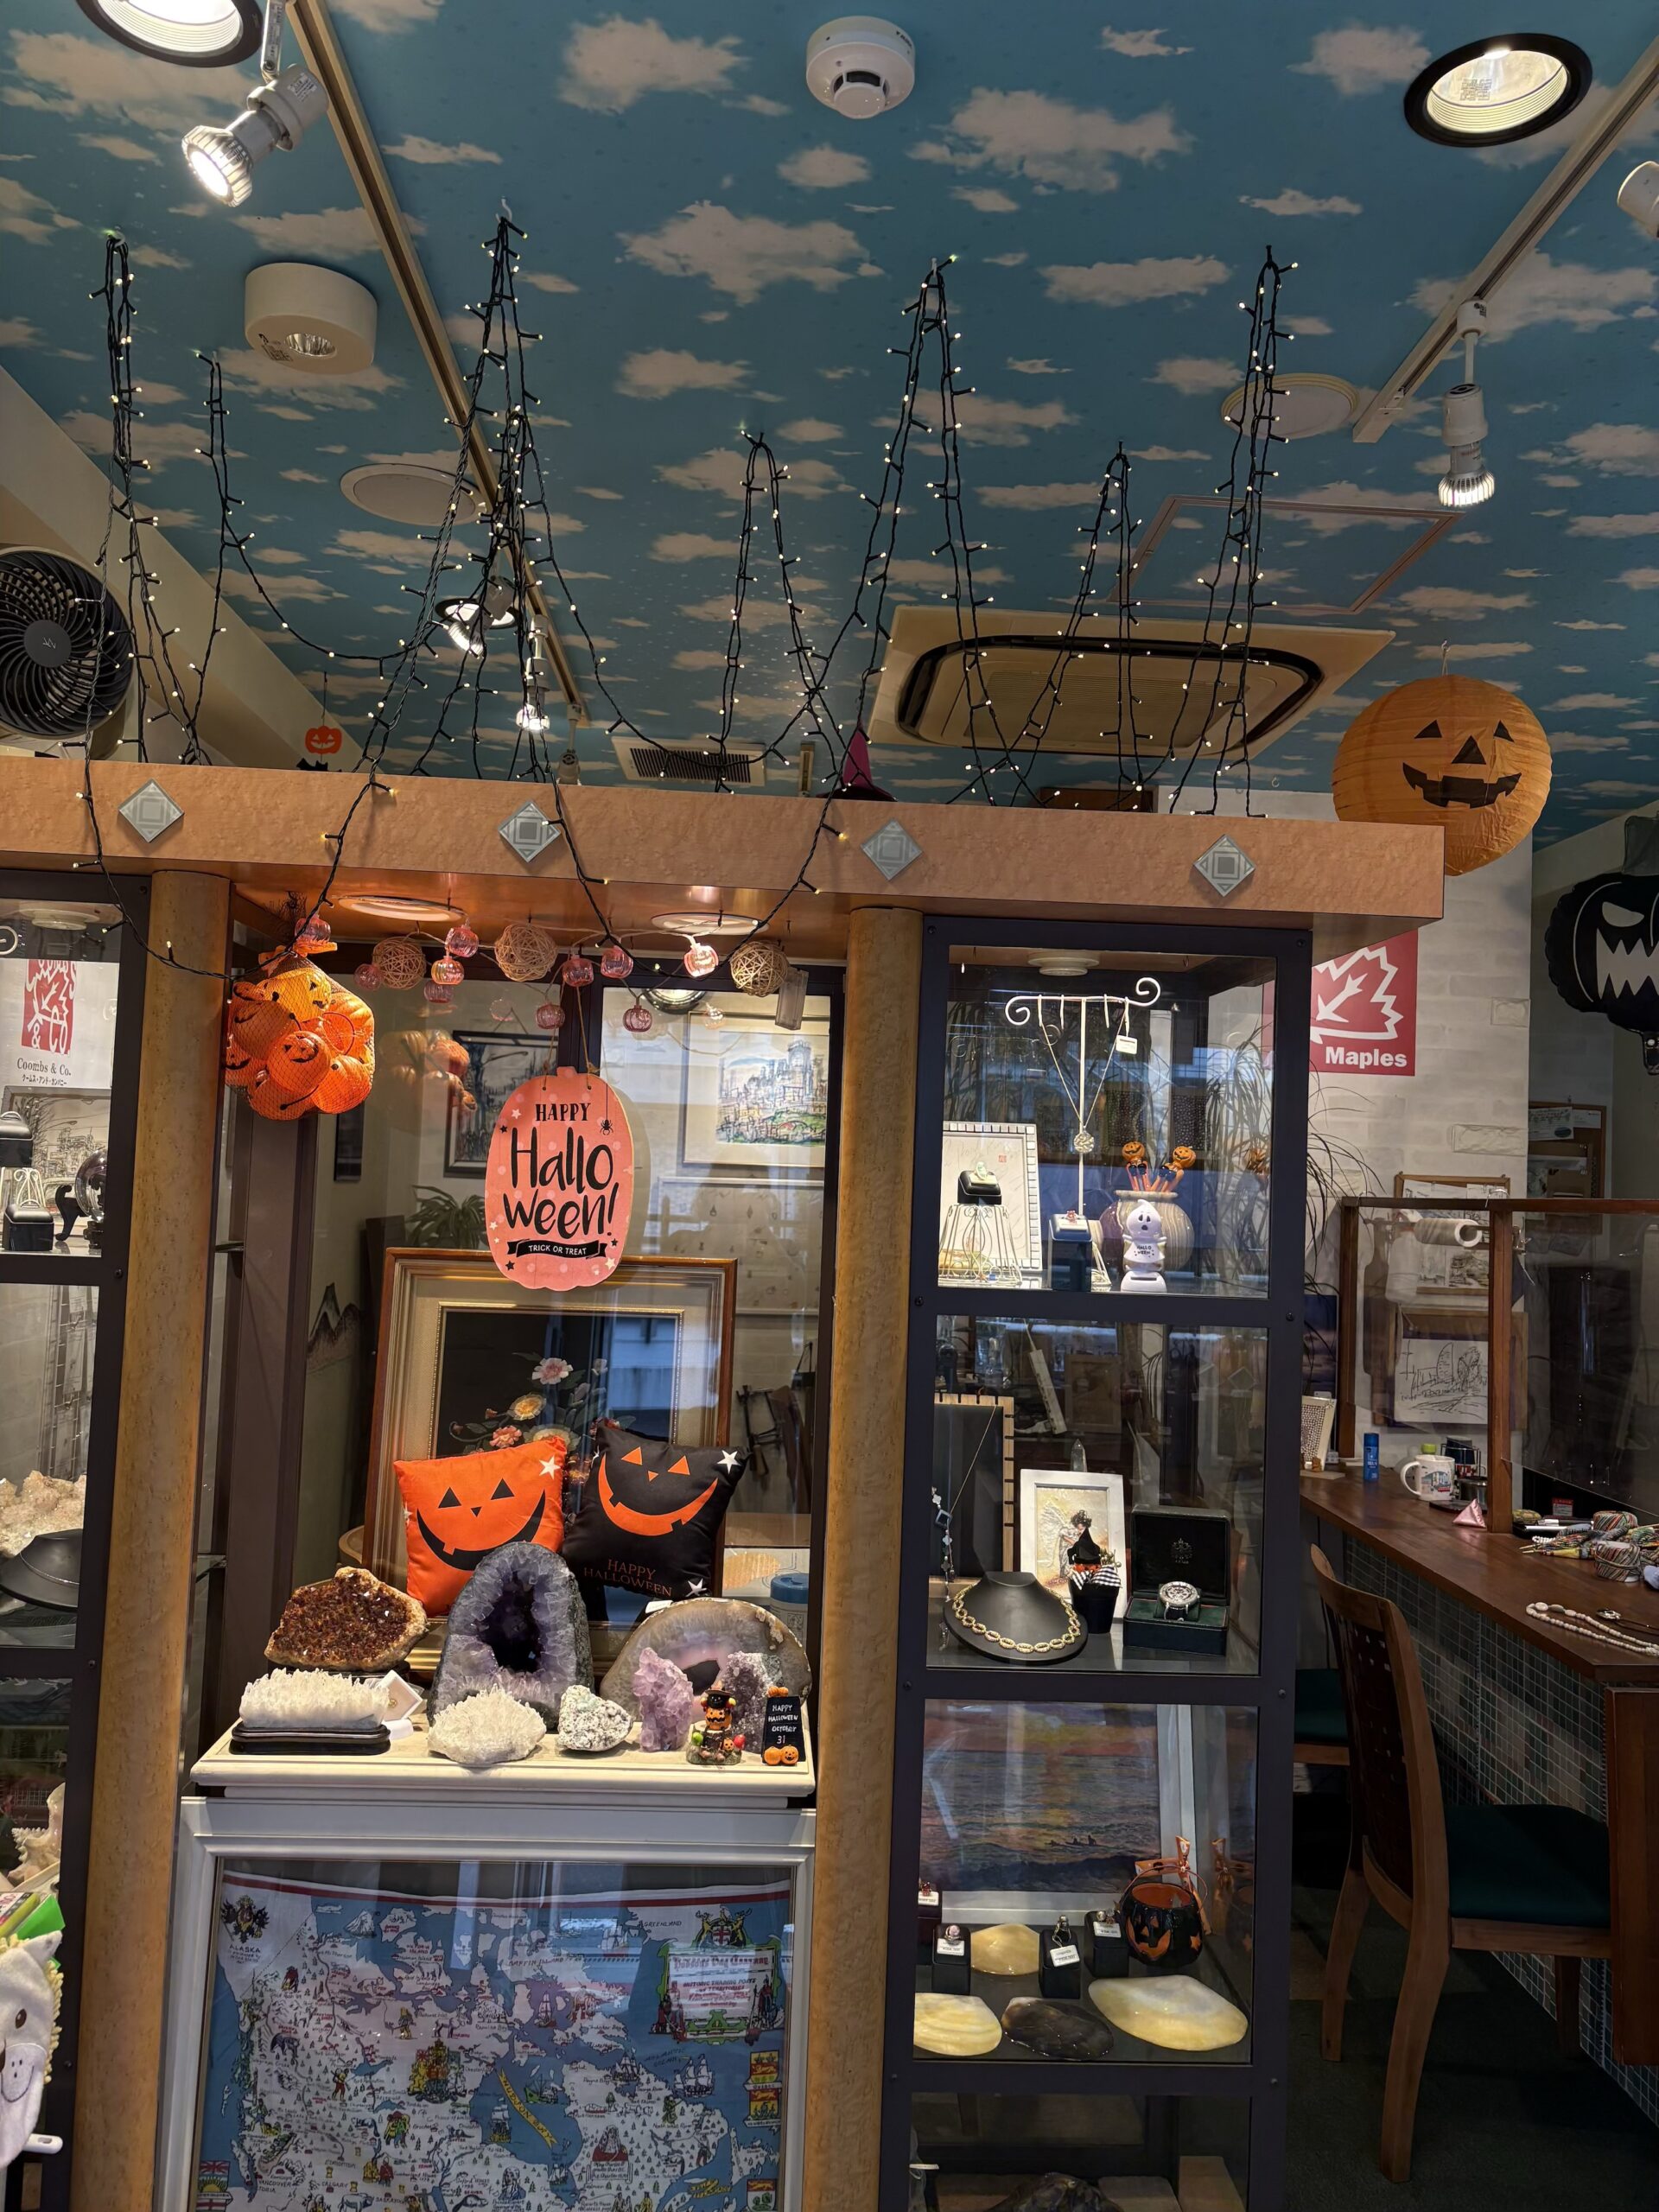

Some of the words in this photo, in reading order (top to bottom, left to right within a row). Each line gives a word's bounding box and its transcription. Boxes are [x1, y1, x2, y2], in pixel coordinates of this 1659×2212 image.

[16, 1057, 48, 1073] Coombs
[50, 1063, 57, 1074] &
[59, 1064, 72, 1076] Co.
[1325, 1046, 1408, 1069] Maples
[536, 1103, 591, 1122] HAPPY
[511, 1127, 613, 1194] Hallo
[503, 1182, 619, 1239] ween!
[528, 1244, 550, 1253] TRICK
[553, 1245, 563, 1254] OR
[565, 1247, 587, 1255] TREAT
[607, 1559, 656, 1580] HAPPY
[583, 1567, 672, 1597] HALLOWEEN
[772, 1704, 792, 1713] HAPPY
[776, 1735, 786, 1744] 31
[229, 1943, 261, 1953] ALASKA
